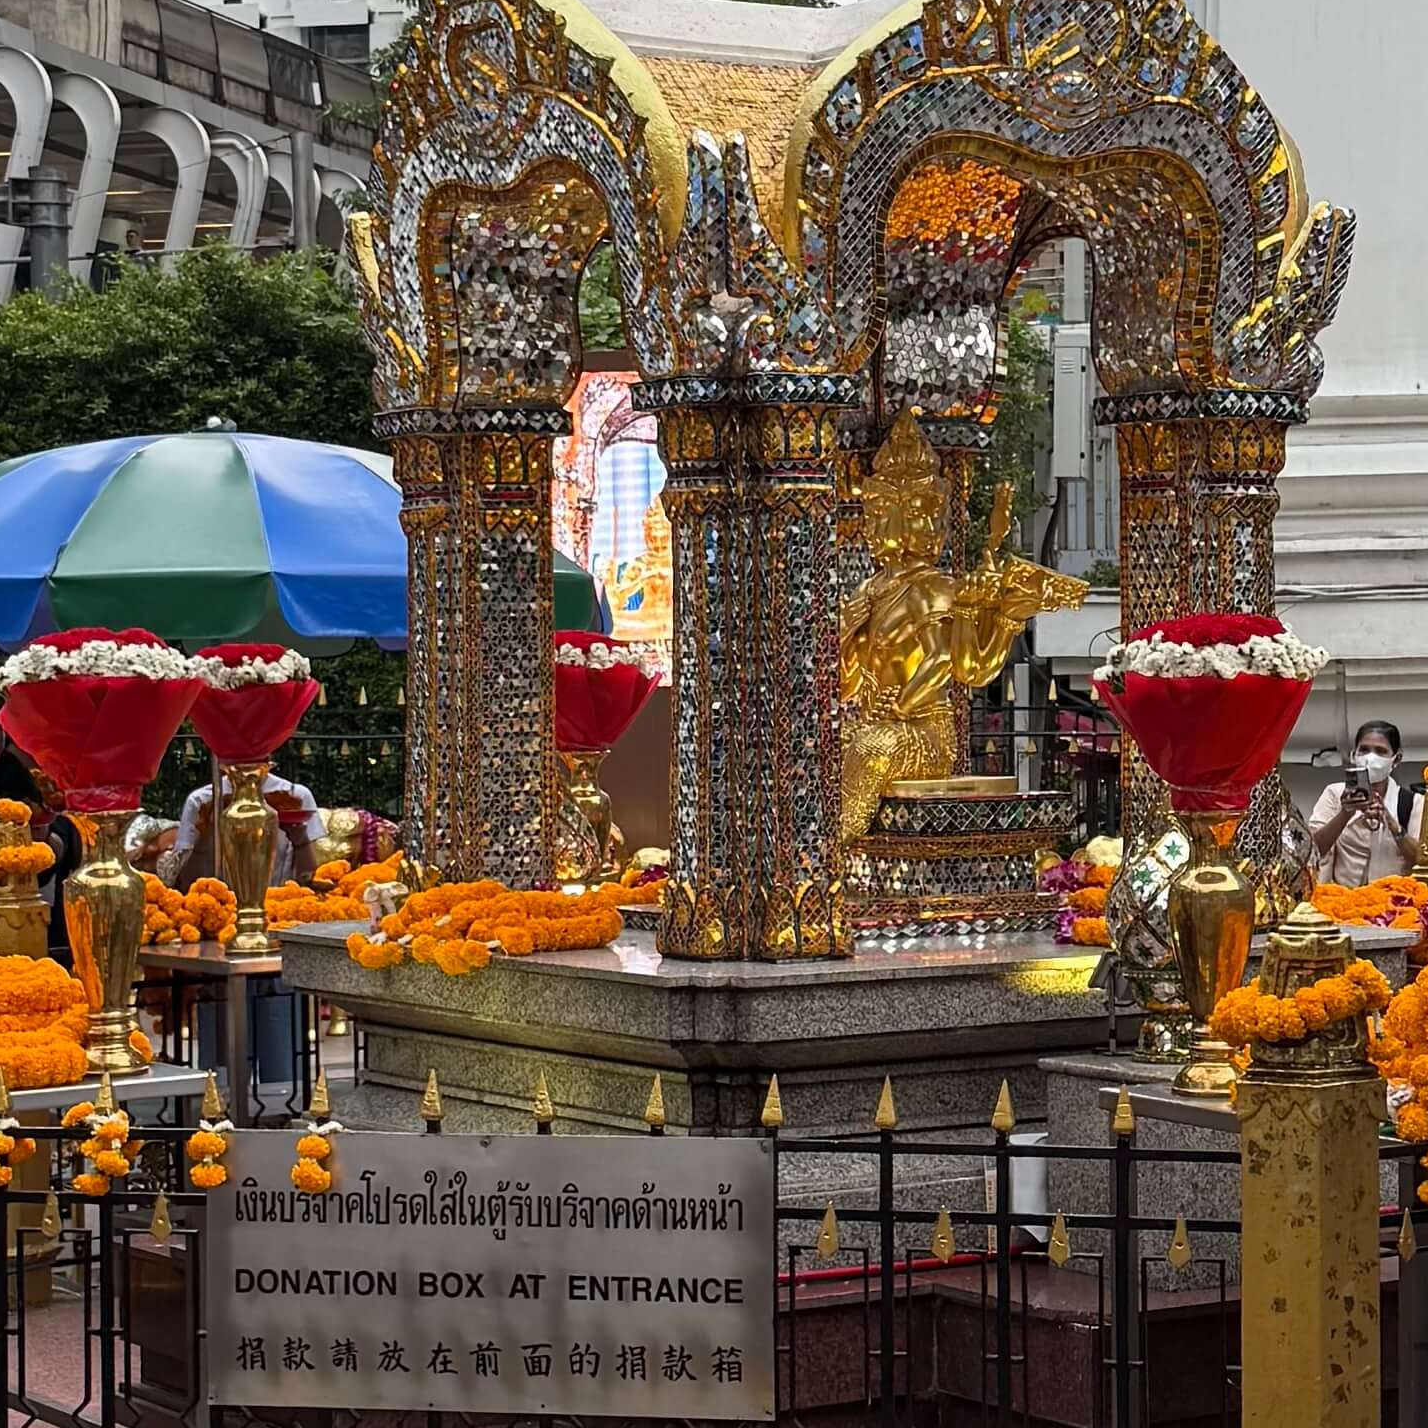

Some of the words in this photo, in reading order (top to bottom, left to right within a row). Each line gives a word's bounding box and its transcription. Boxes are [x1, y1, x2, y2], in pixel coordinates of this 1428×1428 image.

[235, 1268, 397, 1297] DONATION
[418, 1272, 485, 1298] BOX
[508, 1273, 547, 1300] AT
[568, 1275, 744, 1304] ENTRANCE
